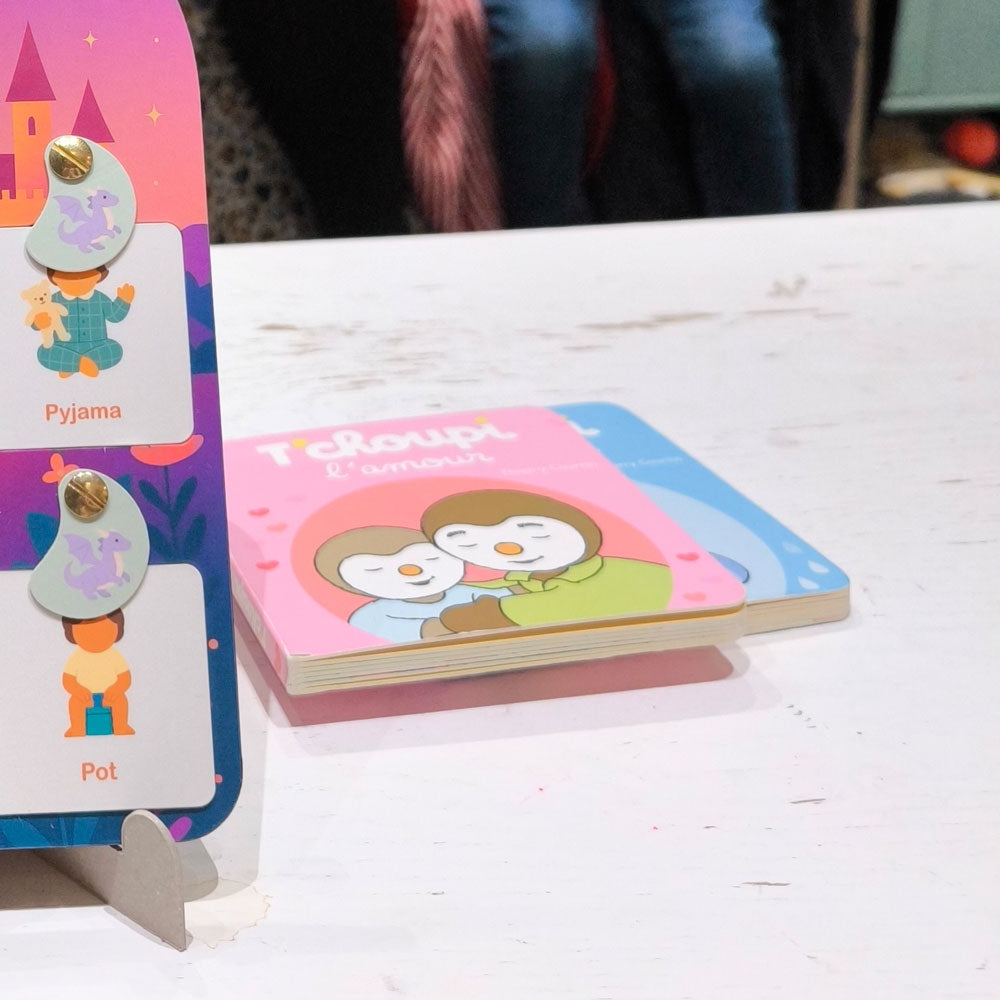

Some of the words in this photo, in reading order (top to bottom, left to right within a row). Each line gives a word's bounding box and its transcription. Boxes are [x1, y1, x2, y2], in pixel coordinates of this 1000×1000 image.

[44, 402, 122, 425] Pyjama
[256, 416, 518, 467] T'choupi
[325, 452, 494, 479] l'amour
[81, 761, 118, 782] Pot
